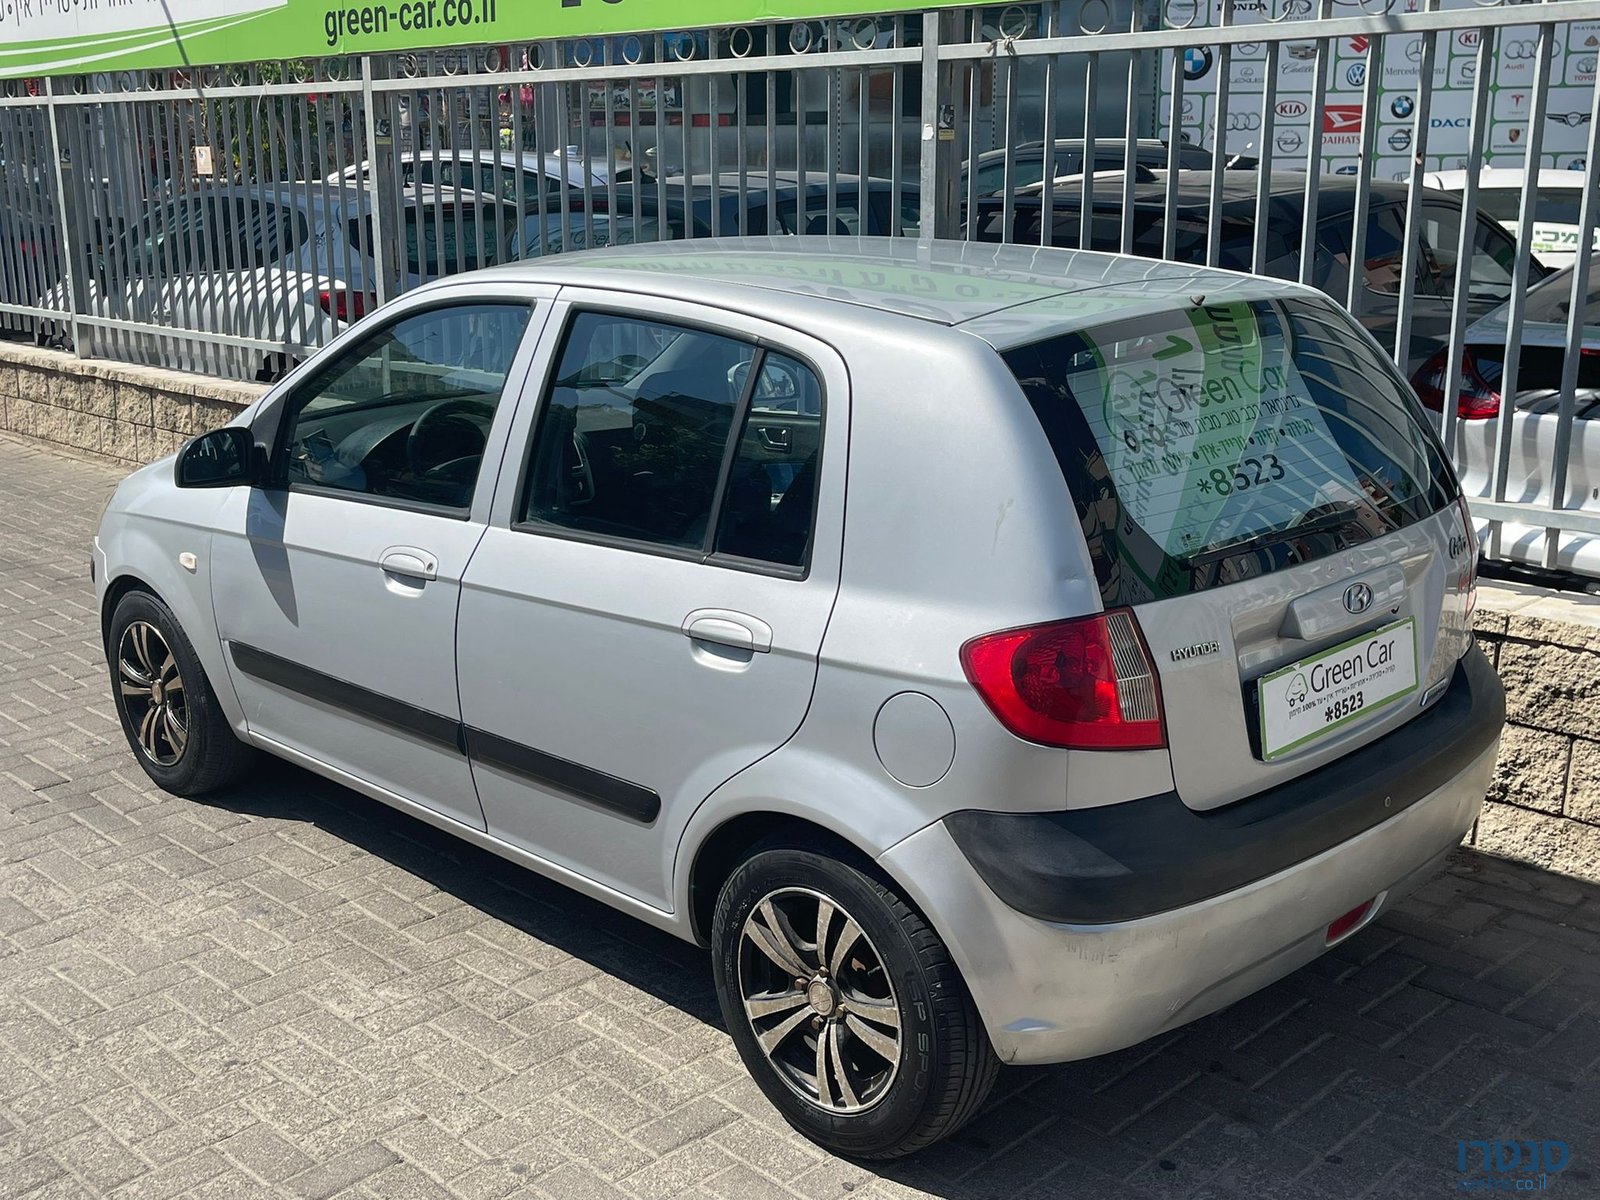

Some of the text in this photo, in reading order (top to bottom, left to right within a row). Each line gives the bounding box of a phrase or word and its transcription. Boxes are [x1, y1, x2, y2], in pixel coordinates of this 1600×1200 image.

[324, 0, 496, 46] green-car.co.il
[1280, 105, 1302, 114] KIA
[1431, 118, 1471, 128] DACI
[1156, 360, 1289, 414] Green Car
[1221, 410, 1241, 426] טוב
[1241, 404, 1262, 421] רכב
[1170, 640, 1221, 662] HYUNDAI
[1311, 640, 1395, 693] Green Car
[1302, 700, 1316, 712] 100%
